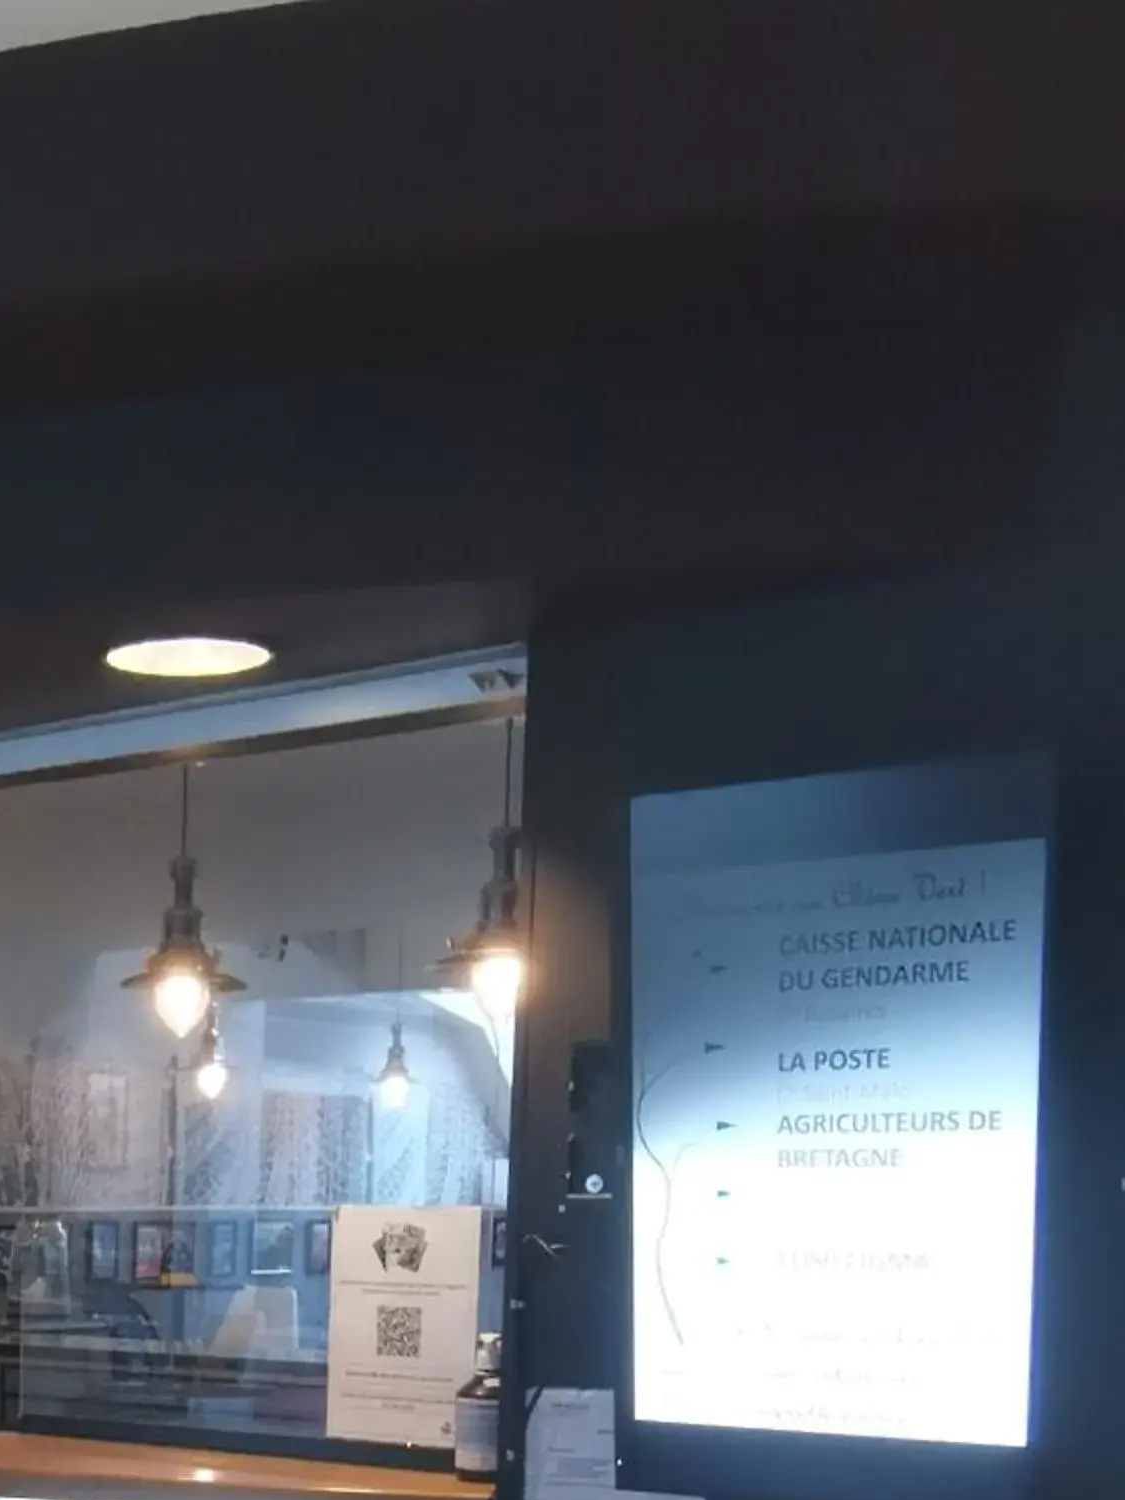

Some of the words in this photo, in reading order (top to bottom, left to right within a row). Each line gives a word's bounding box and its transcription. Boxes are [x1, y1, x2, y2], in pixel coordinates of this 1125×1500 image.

[779, 929, 860, 959] CAISSE
[869, 918, 1018, 952] NATIONALE
[778, 968, 814, 993] DU
[821, 959, 971, 990] GENDARME
[778, 1050, 806, 1073] LA
[814, 1047, 892, 1072] POSTE
[777, 1110, 961, 1137] AGRICULTEURS
[968, 1109, 1003, 1132] DE
[777, 1147, 904, 1170] BRETAGNE
